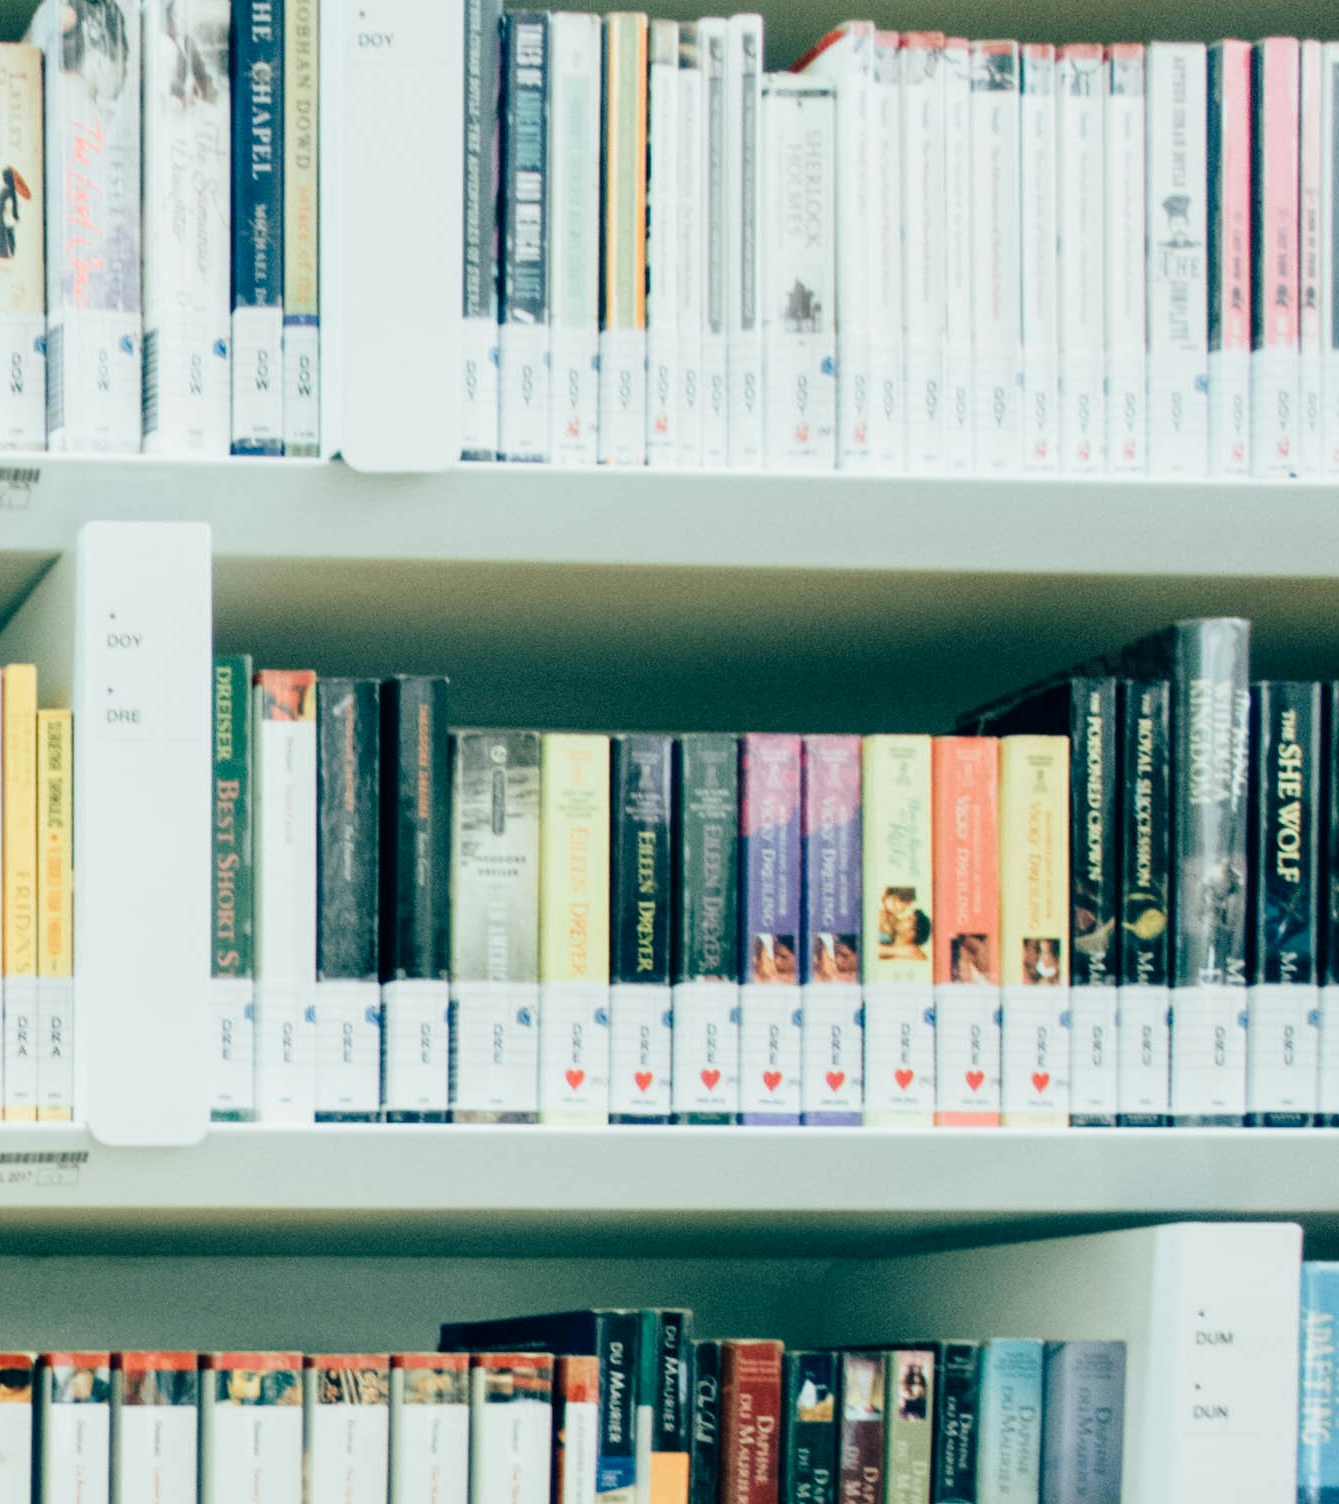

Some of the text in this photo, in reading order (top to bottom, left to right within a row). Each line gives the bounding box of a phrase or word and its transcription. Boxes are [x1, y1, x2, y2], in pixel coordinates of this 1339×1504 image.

[357, 31, 394, 48] DOY
[251, 60, 273, 180] CHAPEL
[106, 633, 142, 650] DOY
[106, 708, 139, 724] DRE
[1192, 1403, 1230, 1419] DUN
